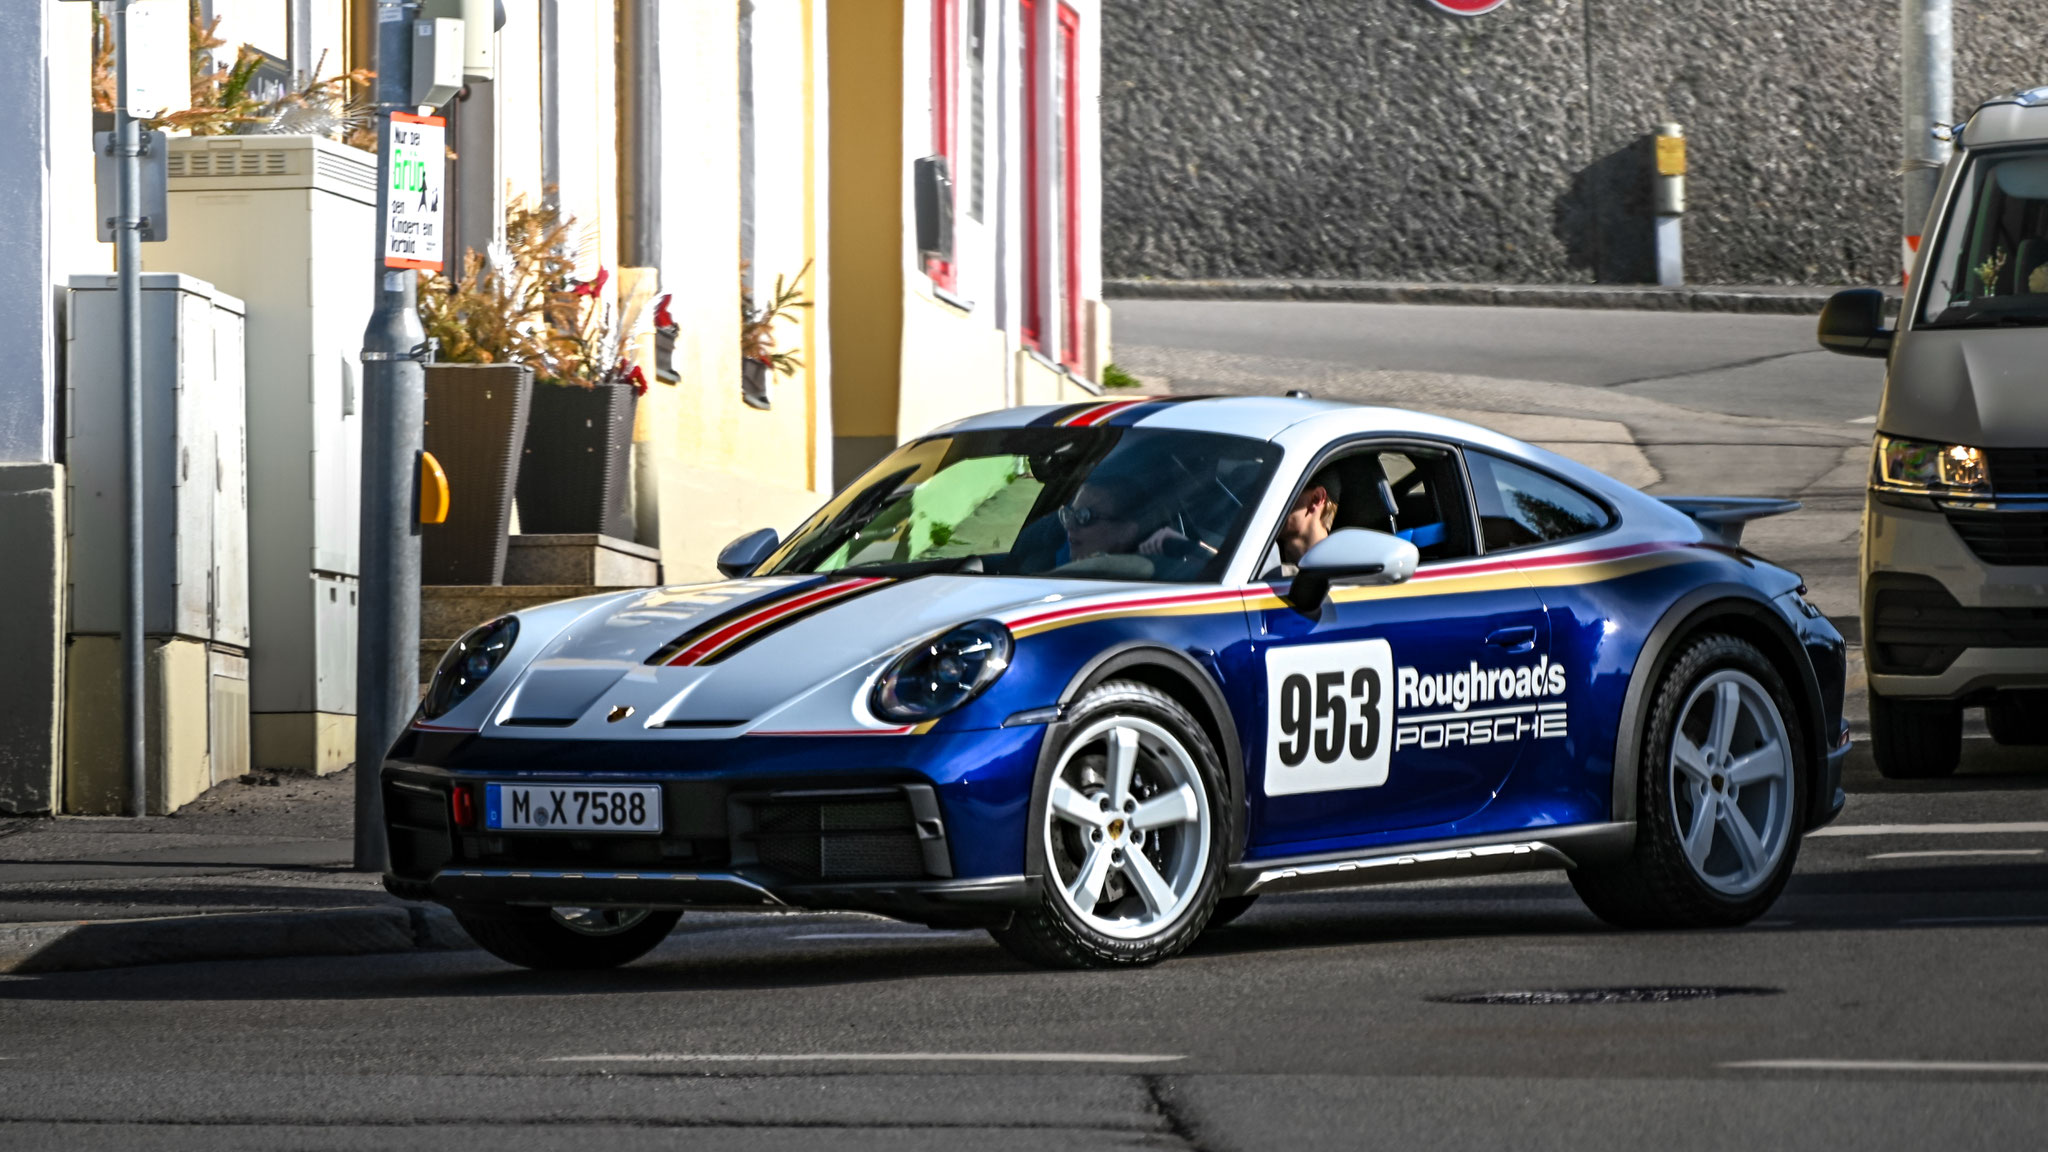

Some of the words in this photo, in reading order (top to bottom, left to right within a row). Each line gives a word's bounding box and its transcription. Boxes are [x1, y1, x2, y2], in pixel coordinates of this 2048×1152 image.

[394, 126, 407, 144] Nur
[393, 148, 426, 193] Grün
[1398, 653, 1567, 713] Roughroads
[1278, 667, 1381, 768] 953
[1395, 711, 1568, 753] PORSCHE
[573, 791, 646, 826] 7588
